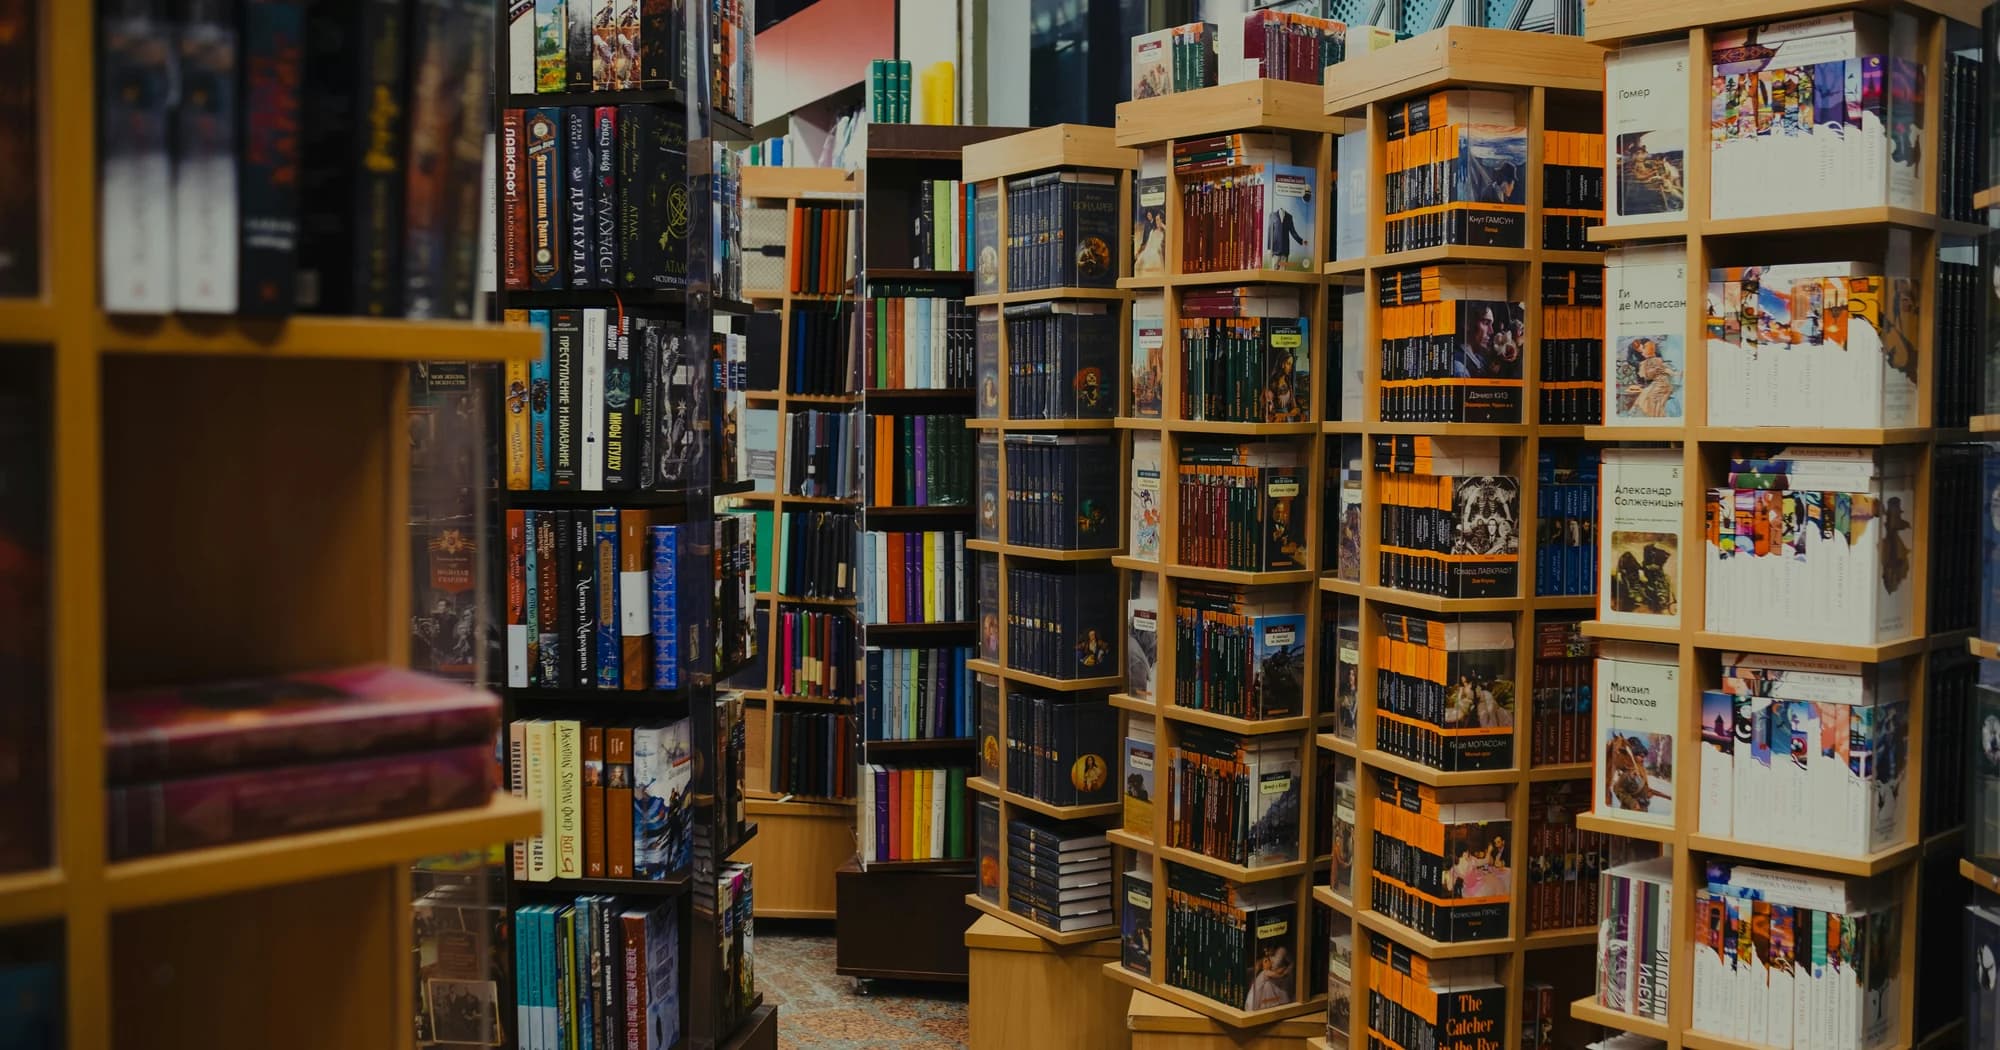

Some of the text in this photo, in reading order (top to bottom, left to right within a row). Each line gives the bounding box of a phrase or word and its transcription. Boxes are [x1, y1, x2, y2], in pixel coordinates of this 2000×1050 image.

[1619, 88, 1650, 100] Гомер
[505, 127, 516, 197] ЛАВКРАФТ
[629, 205, 639, 241] АТЛАС
[1469, 215, 1514, 225] Кнут ГАМСУН
[570, 187, 585, 275] ДРАКУЛА
[1619, 289, 1630, 299] Ги
[1619, 300, 1686, 312] де Мопассан
[559, 335, 570, 467] ПРЕСТУПЛЕНИЕ И НАКАЗАНИЕ
[1494, 391, 1509, 400] КИЗ
[607, 412, 623, 471] МИФЫ КТУЛХУ
[1615, 485, 1672, 497] Александр
[1614, 496, 1684, 508] Солженицын
[576, 576, 593, 613] Мастер
[576, 619, 593, 672] Маргарита
[1611, 682, 1650, 694] Михаил
[1610, 693, 1657, 708] Шолохов
[560, 835, 574, 855] ВОТ
[561, 857, 574, 873] Я
[1639, 962, 1653, 1013] МЭРИ
[1654, 949, 1670, 1017] ШЕЛЛИ
[1458, 994, 1483, 1013] The
[1446, 1016, 1494, 1036] Catcher
